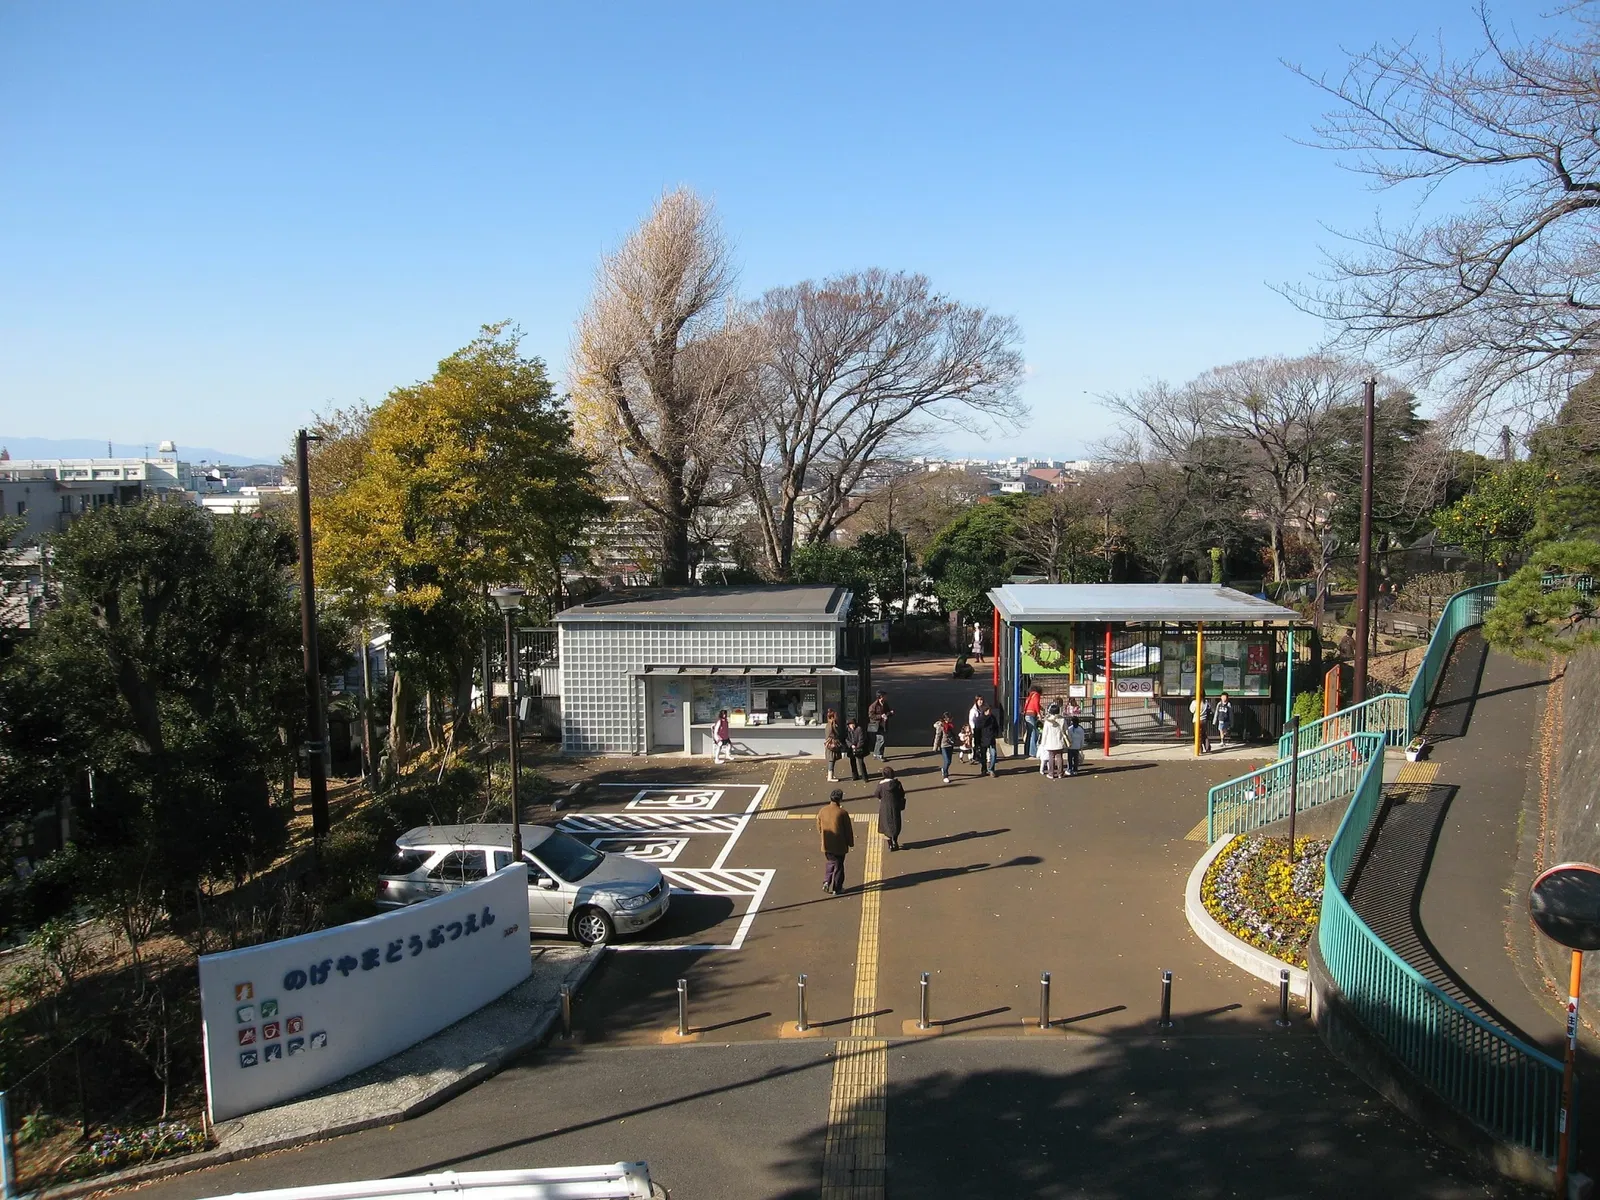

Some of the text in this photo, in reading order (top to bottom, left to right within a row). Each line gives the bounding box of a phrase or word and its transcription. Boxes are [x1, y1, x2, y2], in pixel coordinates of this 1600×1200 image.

[283, 906, 495, 991] のげやまどうぶつえん
